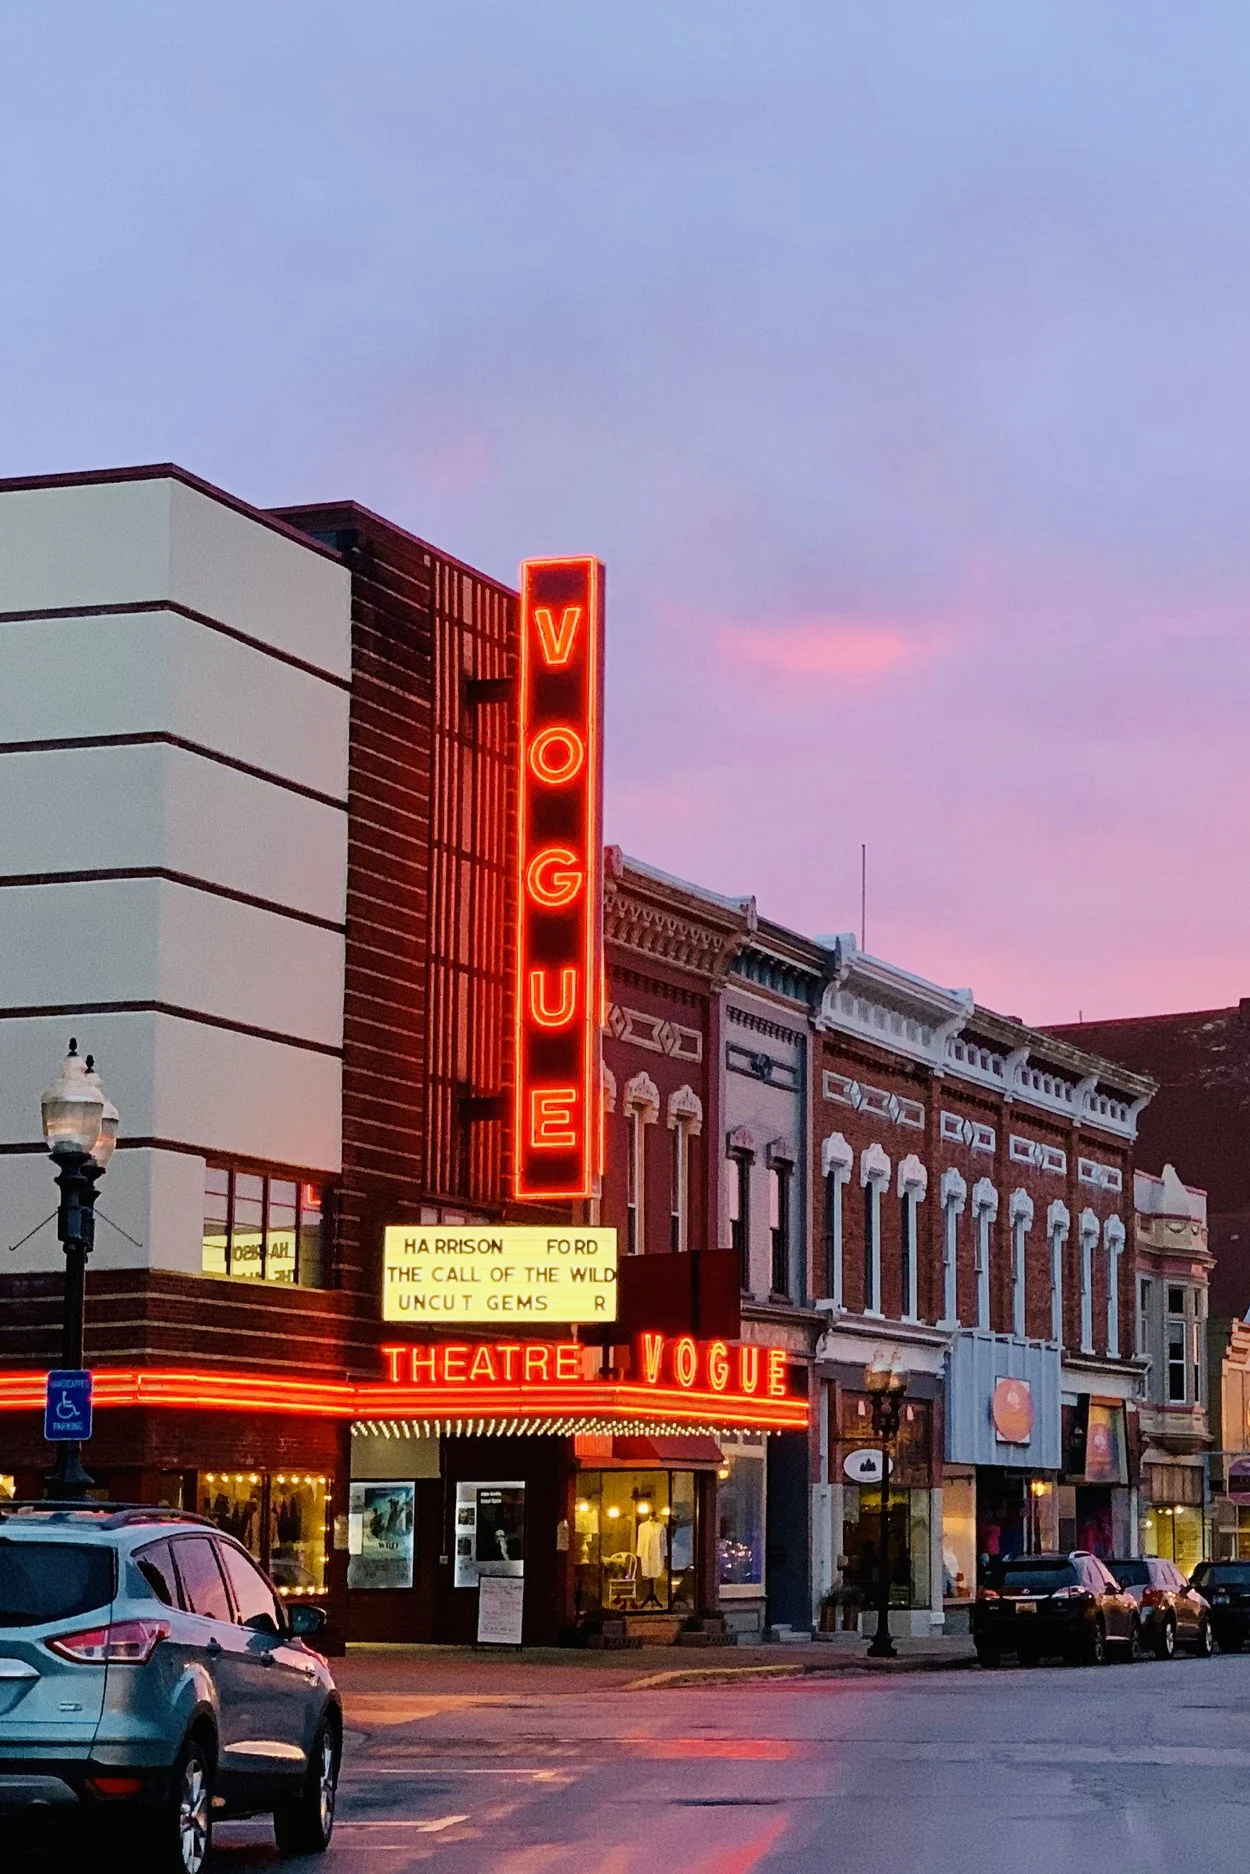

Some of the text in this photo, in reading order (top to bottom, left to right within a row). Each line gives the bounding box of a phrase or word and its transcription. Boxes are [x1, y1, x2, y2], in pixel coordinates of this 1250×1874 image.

[527, 606, 585, 1148] VOGUE
[404, 1238, 599, 1255] HARRISON FORD
[387, 1266, 617, 1283] THE CALL OF THE WILD
[398, 1294, 606, 1311] UNCUT GEMS R
[383, 1332, 790, 1397] THEATRE VOGUE
